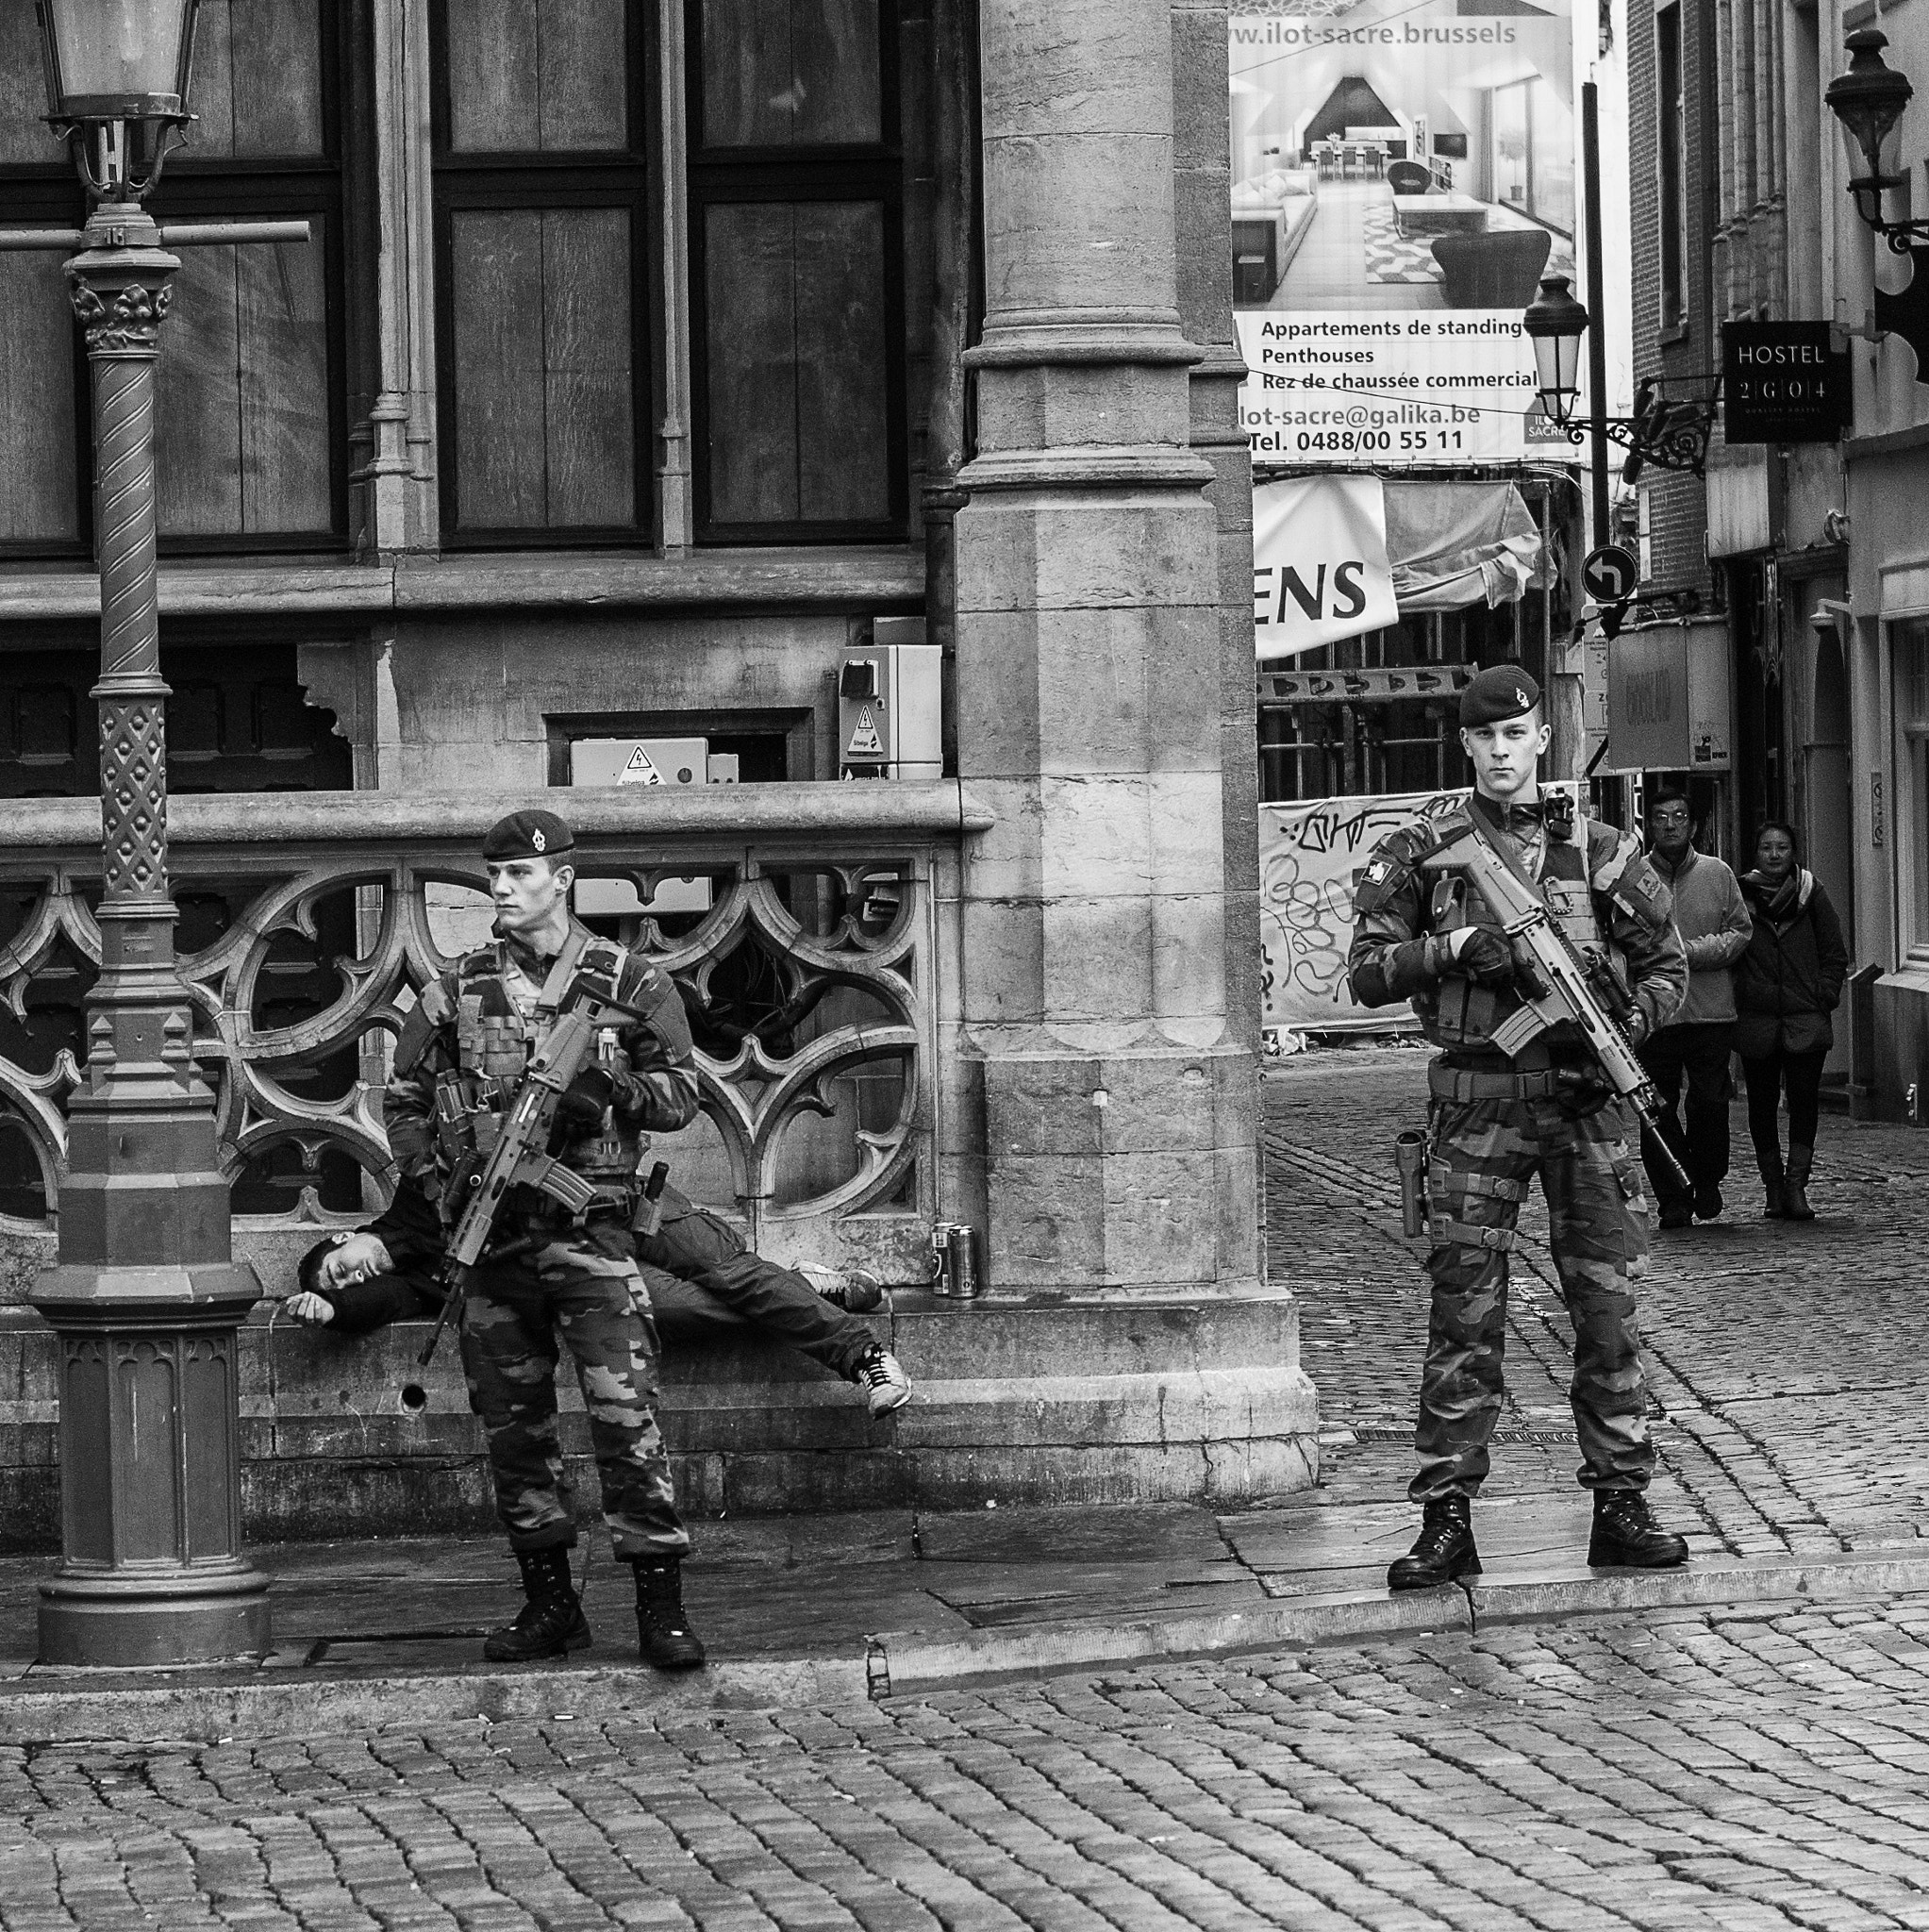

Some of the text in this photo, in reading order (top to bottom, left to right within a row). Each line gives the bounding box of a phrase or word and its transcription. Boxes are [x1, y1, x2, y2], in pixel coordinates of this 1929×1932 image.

[1229, 21, 1516, 44] w.ilot-sacre.brussels
[1261, 318, 1522, 340] Appartements de standing
[1262, 347, 1374, 364] Penthouses
[1738, 345, 1824, 364] HOSTEL
[1262, 369, 1538, 390] Rez de chaussée commercial
[1250, 431, 1461, 452] Tel. 0488/00 55 11
[1254, 560, 1366, 625] ENS
